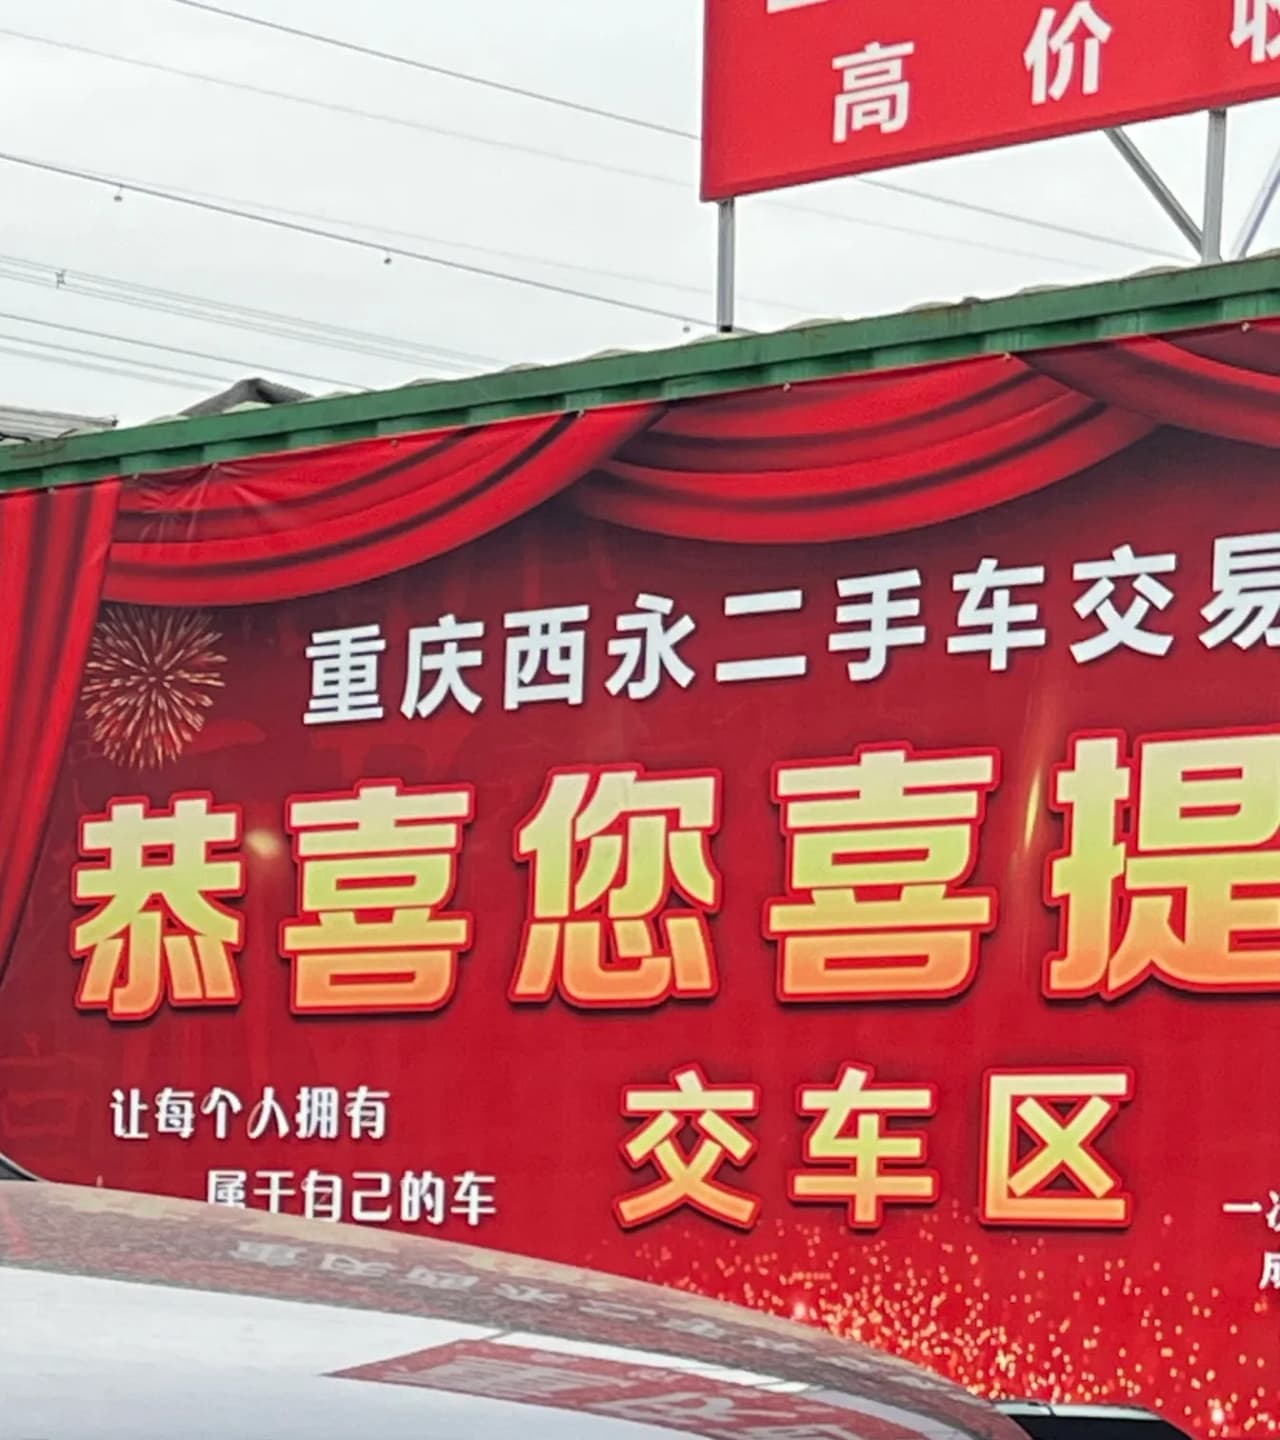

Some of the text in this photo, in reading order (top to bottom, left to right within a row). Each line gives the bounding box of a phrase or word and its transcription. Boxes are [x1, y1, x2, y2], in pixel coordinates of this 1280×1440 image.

[303, 532, 1280, 725] 重庆西永二手车交易
[74, 733, 1280, 1013] 恭喜您喜提
[110, 1085, 390, 1139] 让每个人拥有
[620, 1069, 1127, 1223] 交车区
[207, 1169, 496, 1225] 属于自己的车
